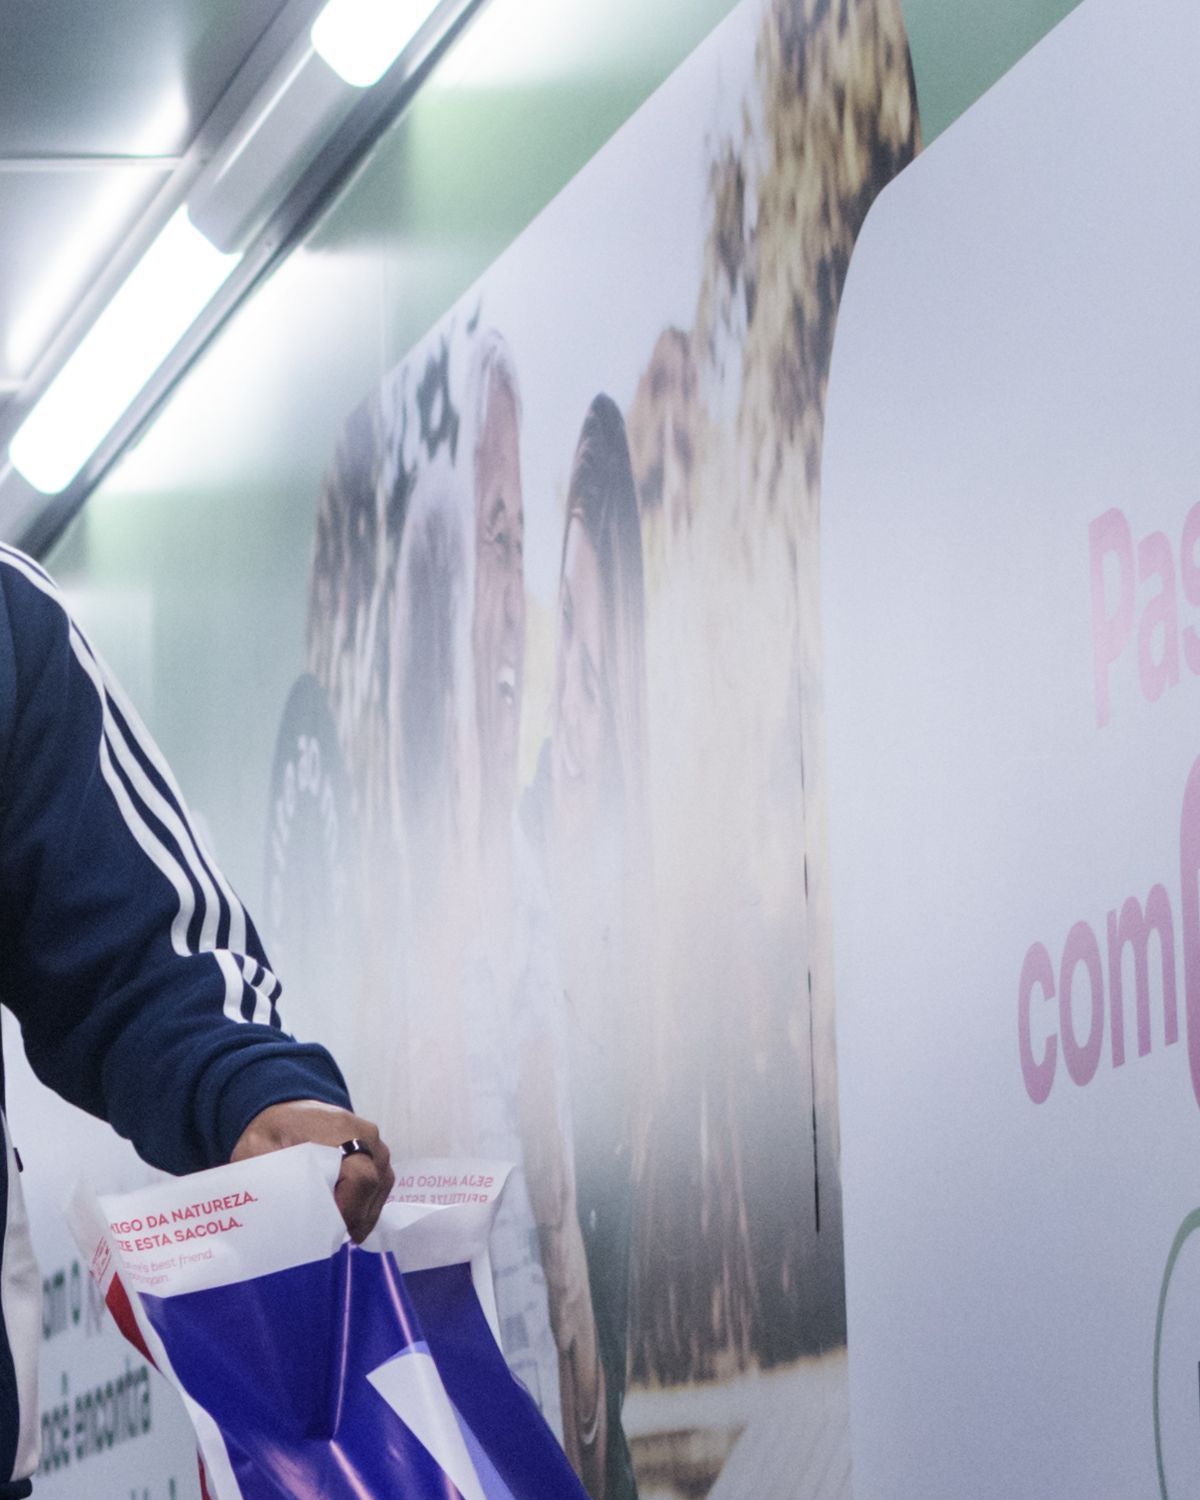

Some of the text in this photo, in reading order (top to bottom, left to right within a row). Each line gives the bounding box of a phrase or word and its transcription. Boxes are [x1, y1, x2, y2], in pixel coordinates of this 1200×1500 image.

[146, 1213, 169, 1229] DA
[171, 1190, 258, 1223] NATUREZA.
[135, 1234, 173, 1251] ESTA
[174, 1216, 243, 1242] SACOLA.
[74, 1355, 152, 1461] encontra
